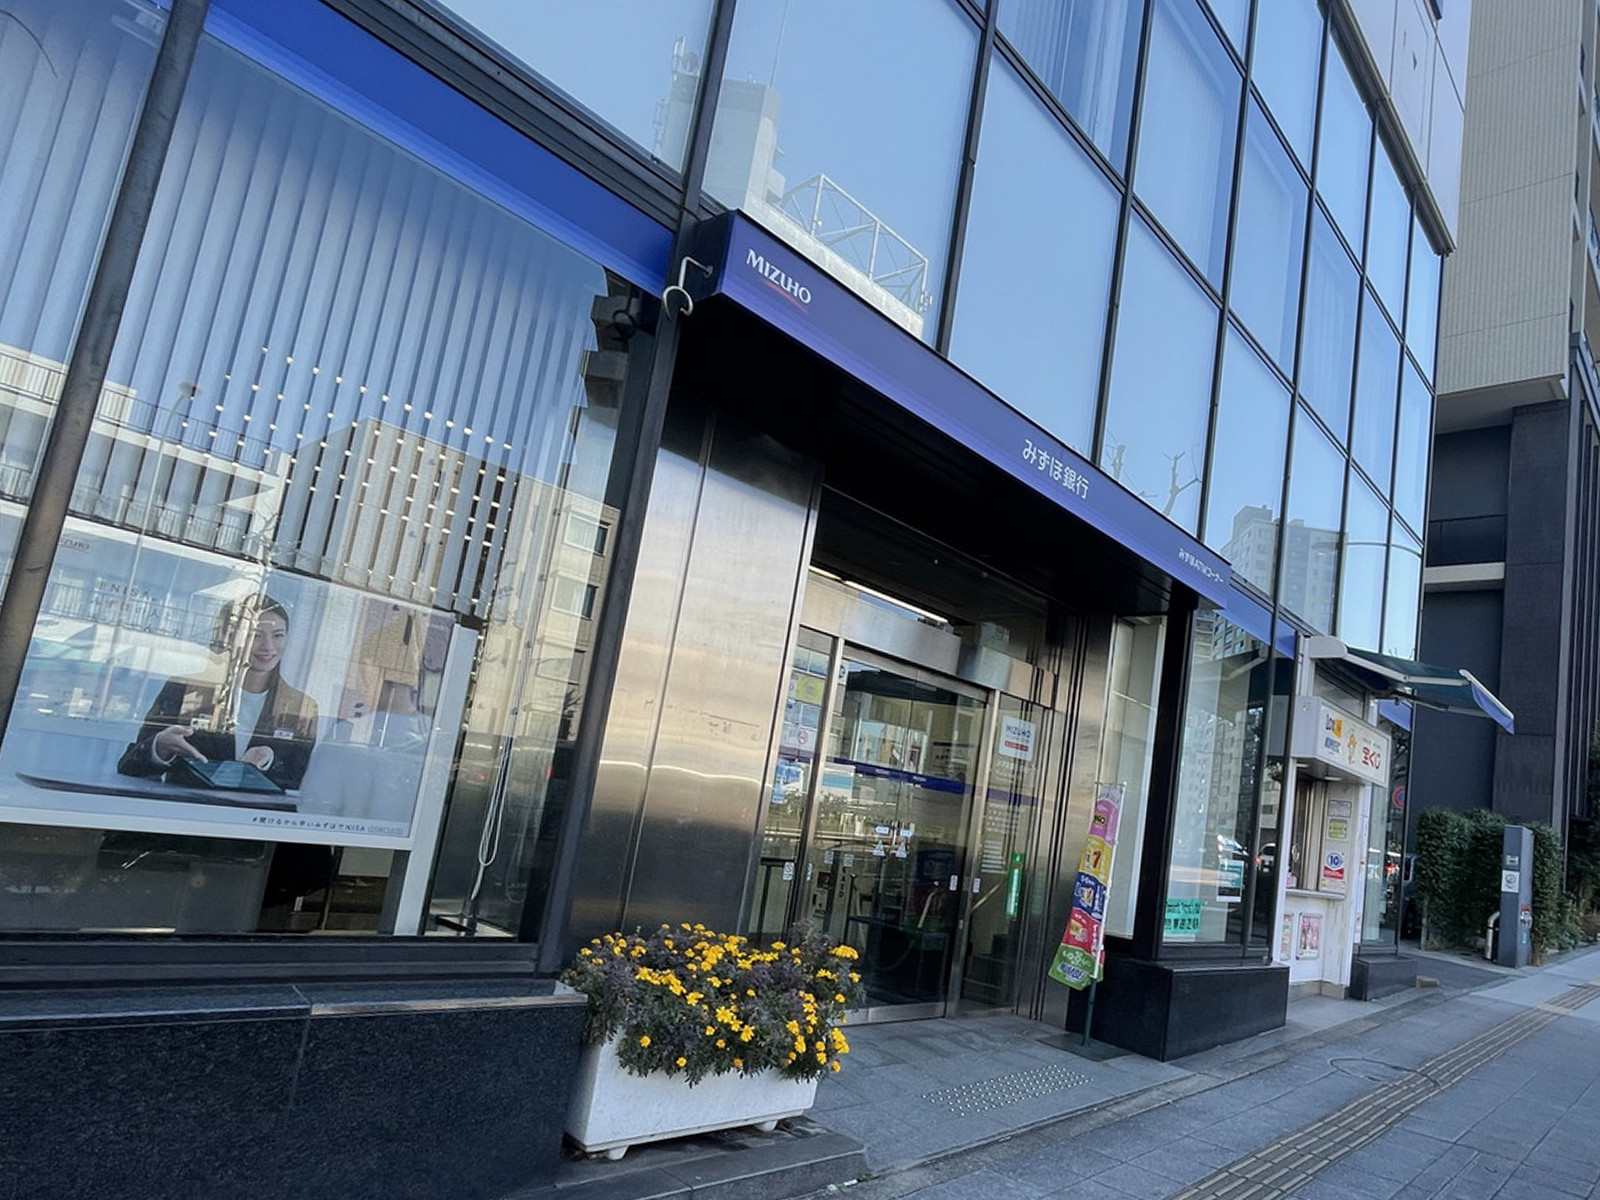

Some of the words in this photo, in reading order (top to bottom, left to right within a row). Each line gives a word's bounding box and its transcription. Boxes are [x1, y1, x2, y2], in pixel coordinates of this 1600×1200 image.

[746, 248, 812, 304] MIZUHO
[1022, 439, 1089, 499] みずほ銀行
[1362, 746, 1381, 770] 宝くじ
